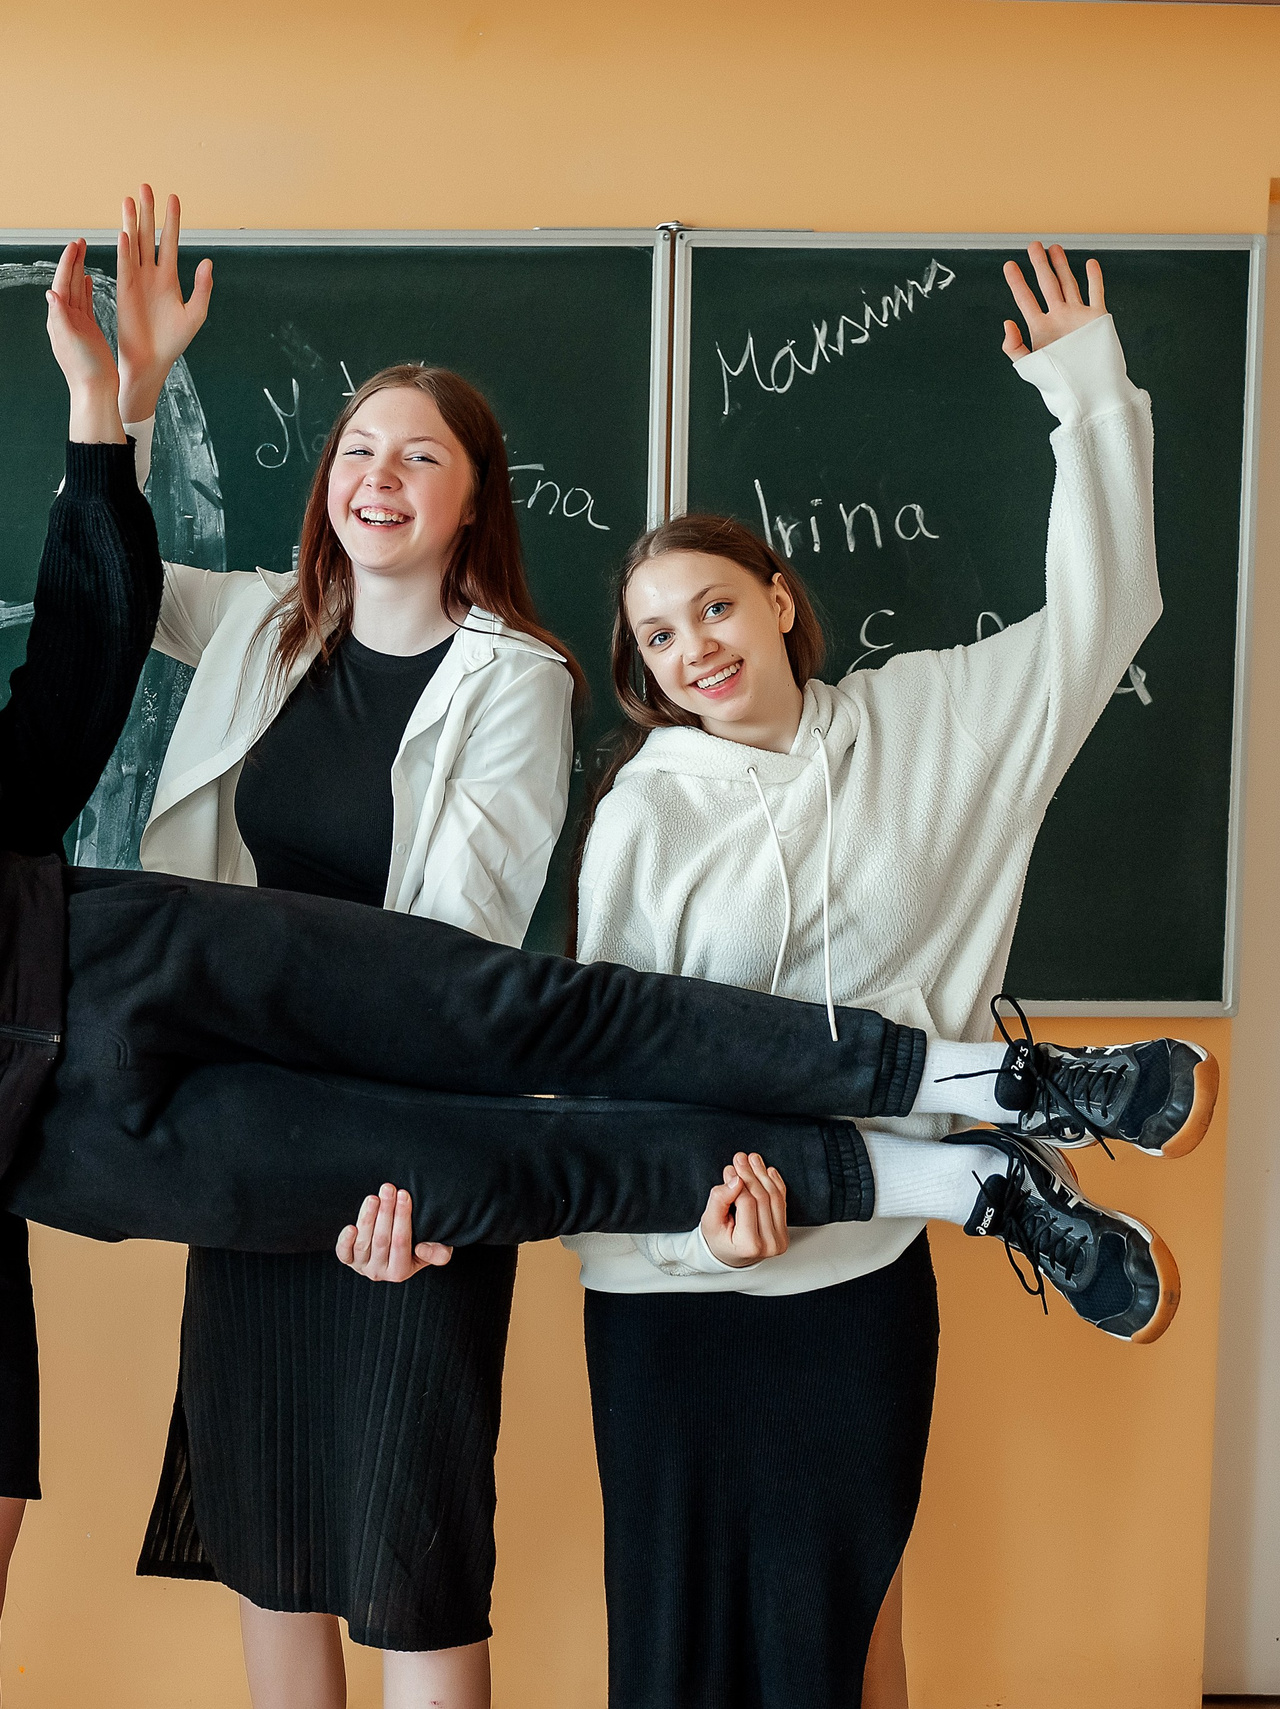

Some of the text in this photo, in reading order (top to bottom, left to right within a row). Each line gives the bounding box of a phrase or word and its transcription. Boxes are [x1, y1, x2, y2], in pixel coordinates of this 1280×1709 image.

[715, 258, 956, 416] Maksims
[753, 478, 940, 559] Irina
[980, 1206, 995, 1229] asics
